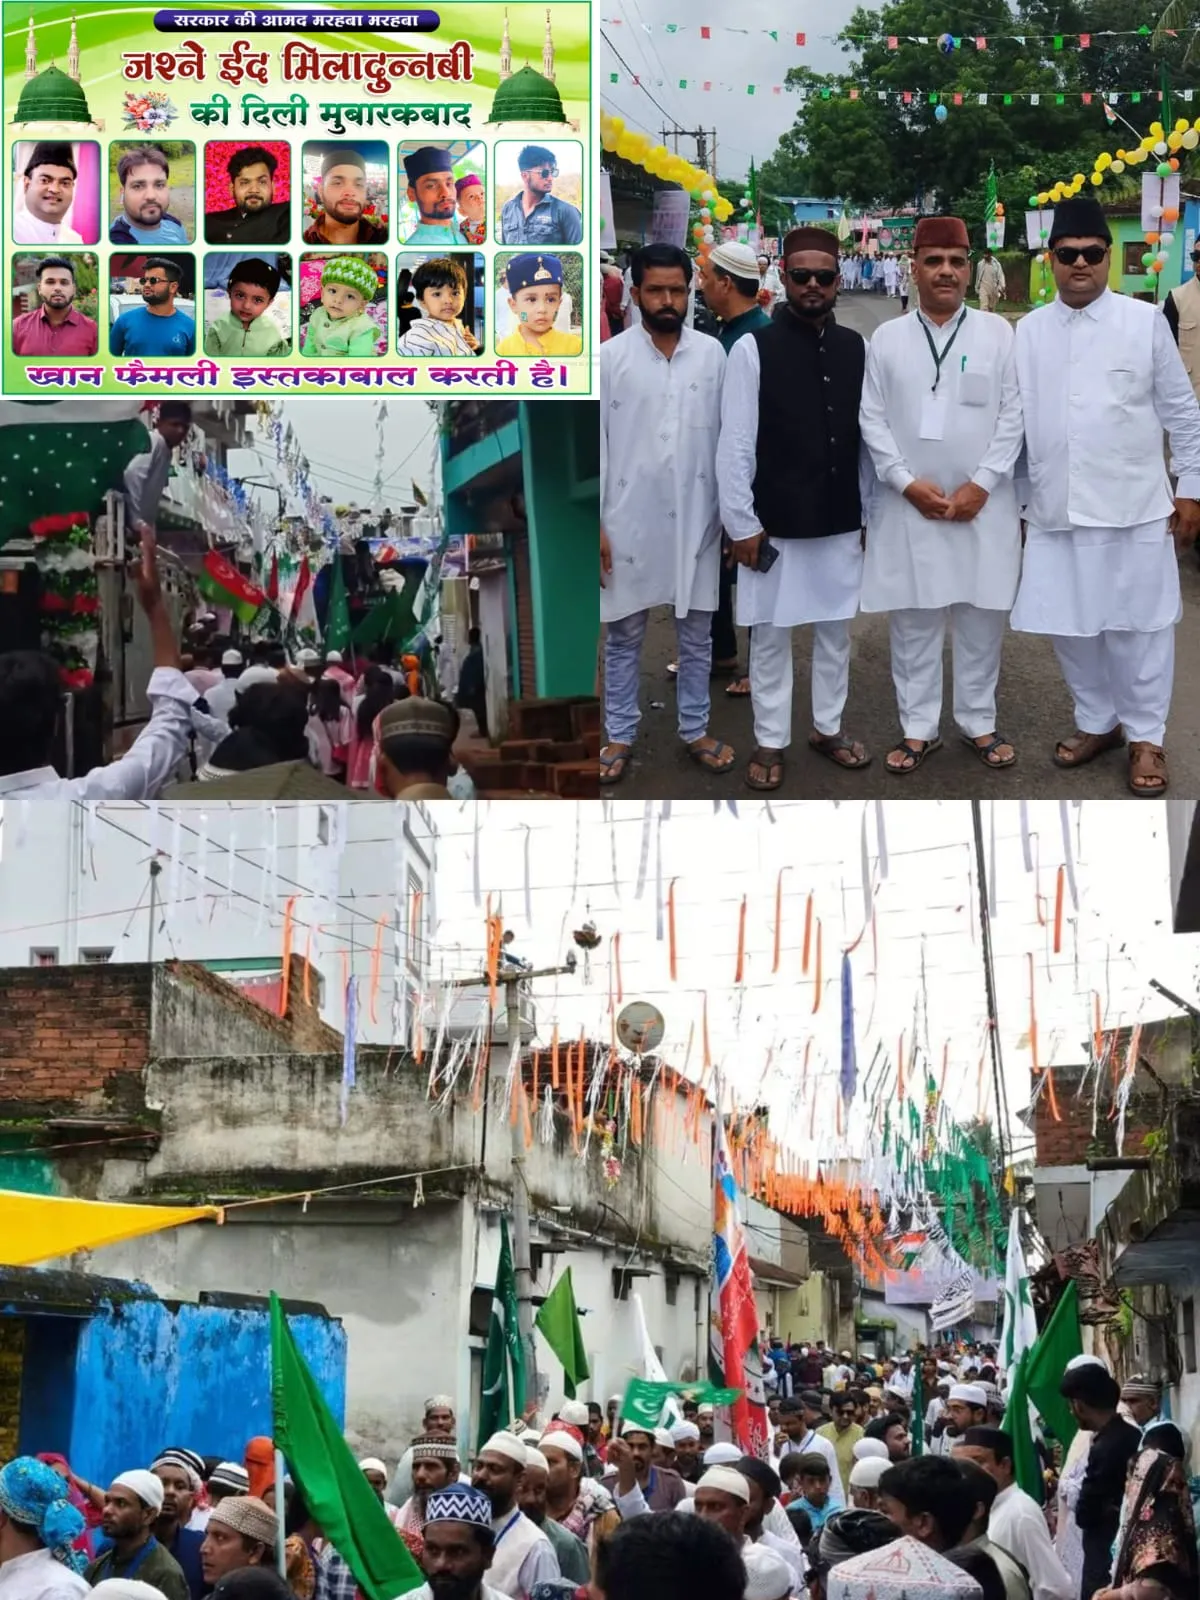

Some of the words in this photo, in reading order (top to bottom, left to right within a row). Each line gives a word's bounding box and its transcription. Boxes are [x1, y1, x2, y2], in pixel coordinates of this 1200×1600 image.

[174, 15, 229, 26] सरकार
[234, 10, 256, 26] की
[262, 15, 308, 26] आमद
[123, 41, 206, 80] जश्ने
[219, 40, 270, 85] ईद
[282, 41, 474, 93] मिलादुन्नबी
[190, 94, 231, 126] की
[241, 94, 309, 128] दिली
[319, 103, 472, 135] मुबारकबाद
[27, 367, 103, 386] खान
[115, 360, 220, 386] फैमली
[231, 367, 417, 389] इस्तकाबाल
[428, 360, 518, 386] करती
